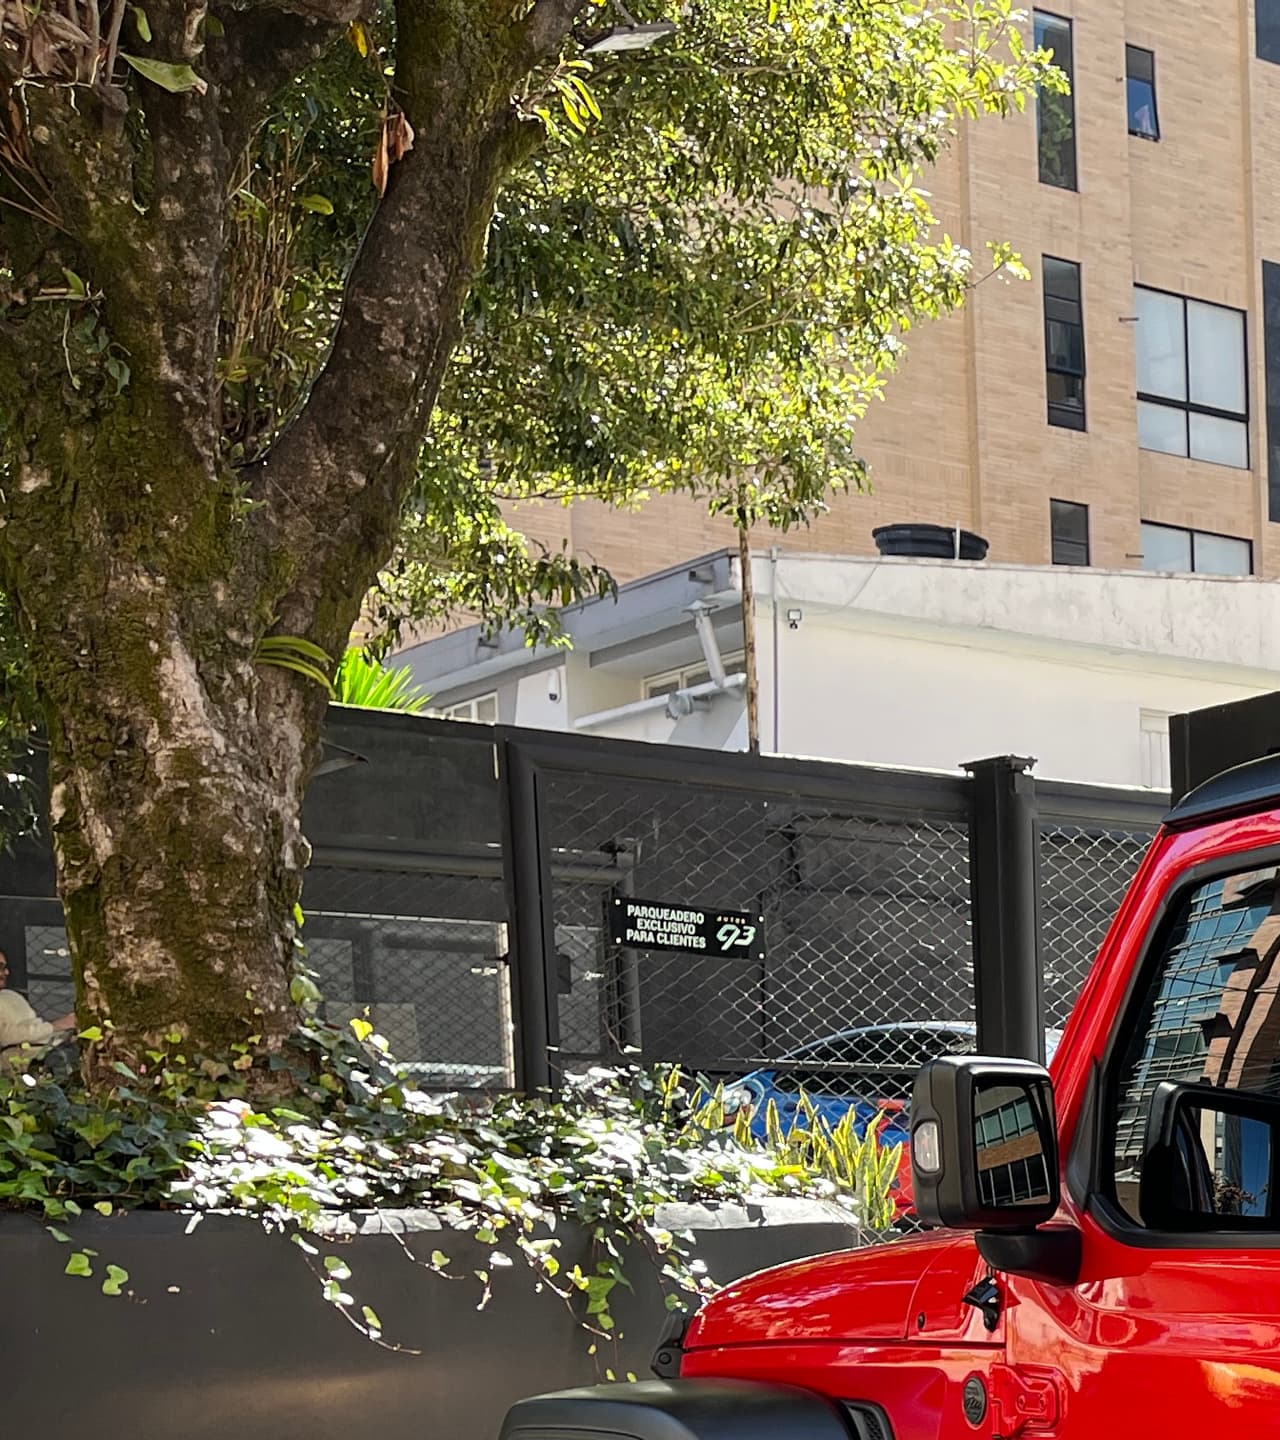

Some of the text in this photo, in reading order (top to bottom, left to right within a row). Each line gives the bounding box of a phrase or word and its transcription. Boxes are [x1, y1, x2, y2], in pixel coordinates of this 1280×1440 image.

[627, 904, 705, 924] PARQUEADERO
[637, 918, 696, 935] EXCLUSIVO
[626, 929, 706, 949] PARA CLIENTES
[716, 923, 756, 951] 93
